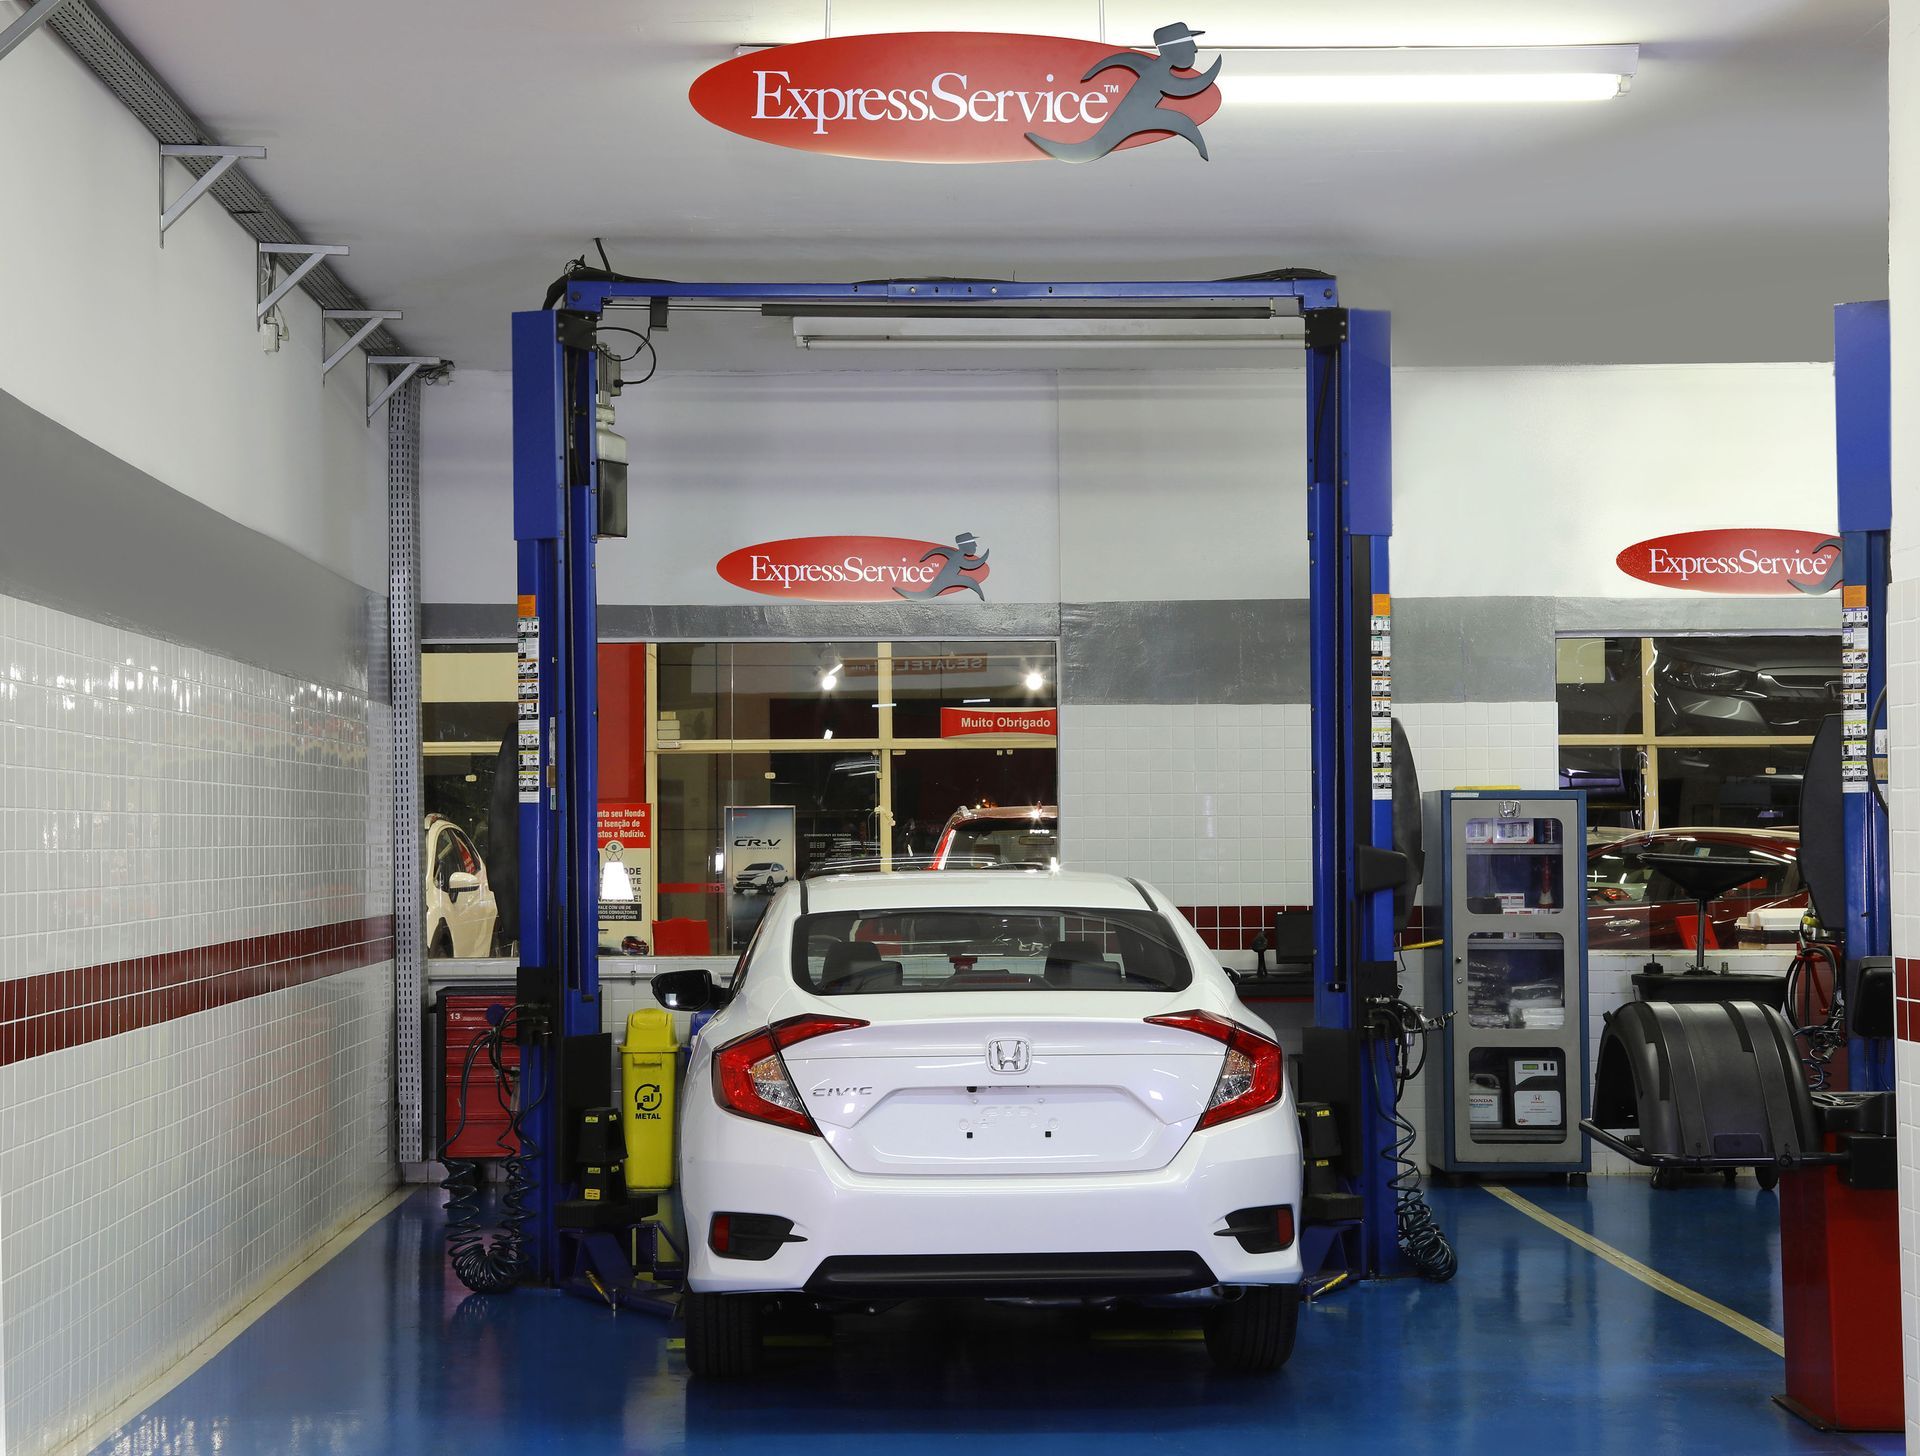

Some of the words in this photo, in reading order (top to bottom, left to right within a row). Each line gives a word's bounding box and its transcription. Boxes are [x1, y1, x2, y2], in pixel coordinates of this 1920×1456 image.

[961, 717, 993, 728] Muito
[997, 717, 1051, 730] Obrigado
[624, 809, 646, 818] Honda
[604, 819, 630, 829] Isenção
[631, 819, 641, 828] de
[619, 829, 646, 838] Rodízio.
[734, 838, 782, 847] CR-V
[450, 1012, 461, 1020] 13
[812, 1086, 873, 1097] CIVIC
